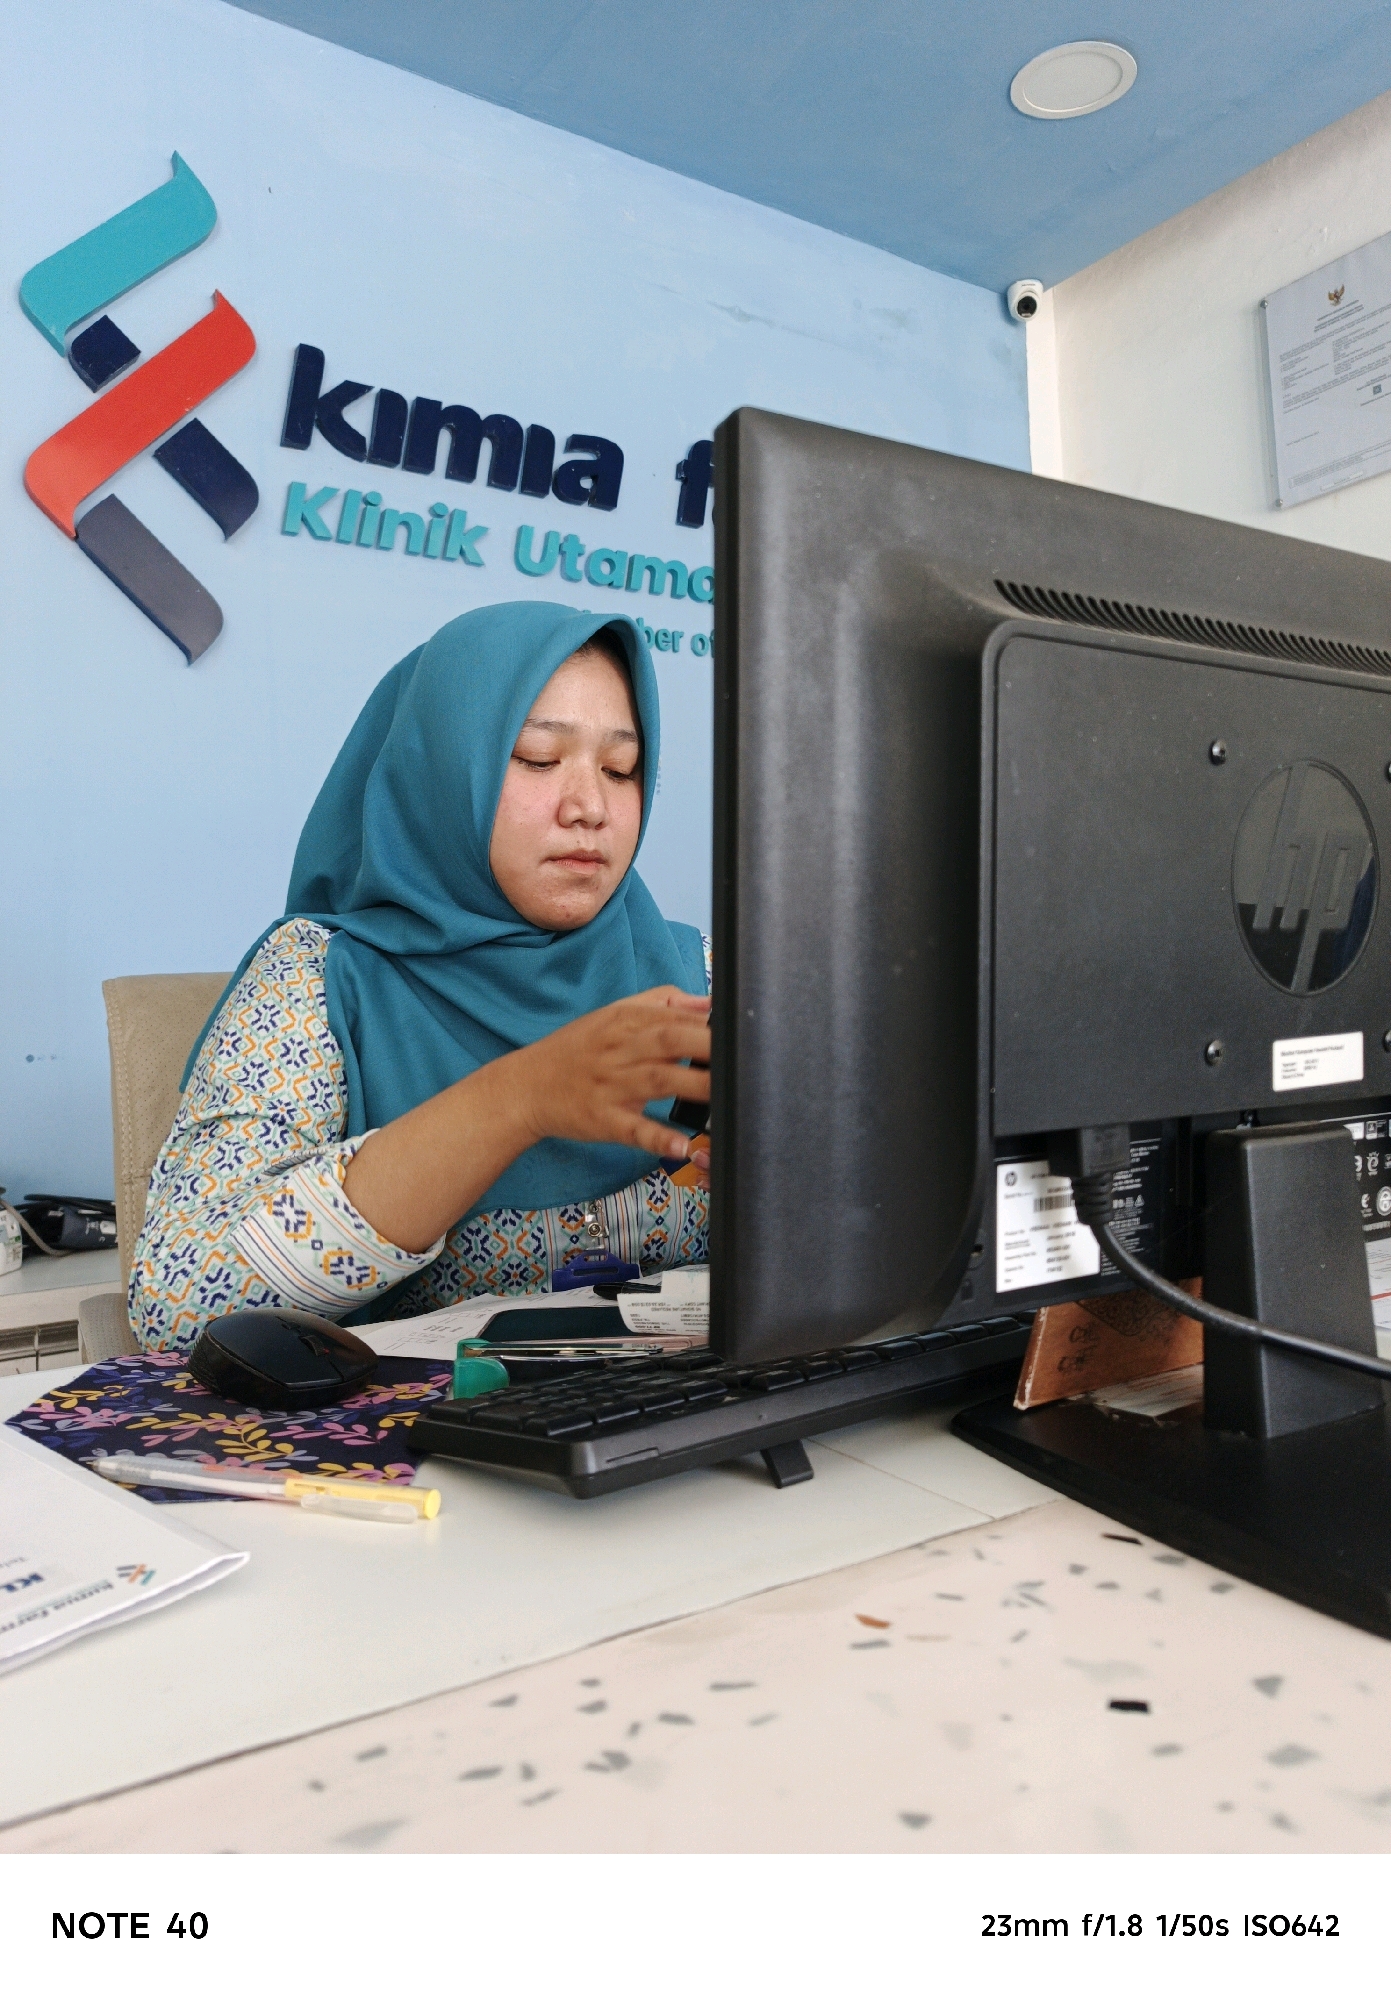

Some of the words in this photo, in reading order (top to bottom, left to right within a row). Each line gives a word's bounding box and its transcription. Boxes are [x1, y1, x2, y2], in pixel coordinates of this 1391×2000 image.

[280, 342, 625, 512] kimia
[675, 439, 715, 529] f
[281, 481, 489, 568] Klinik
[1252, 760, 1373, 993] hp
